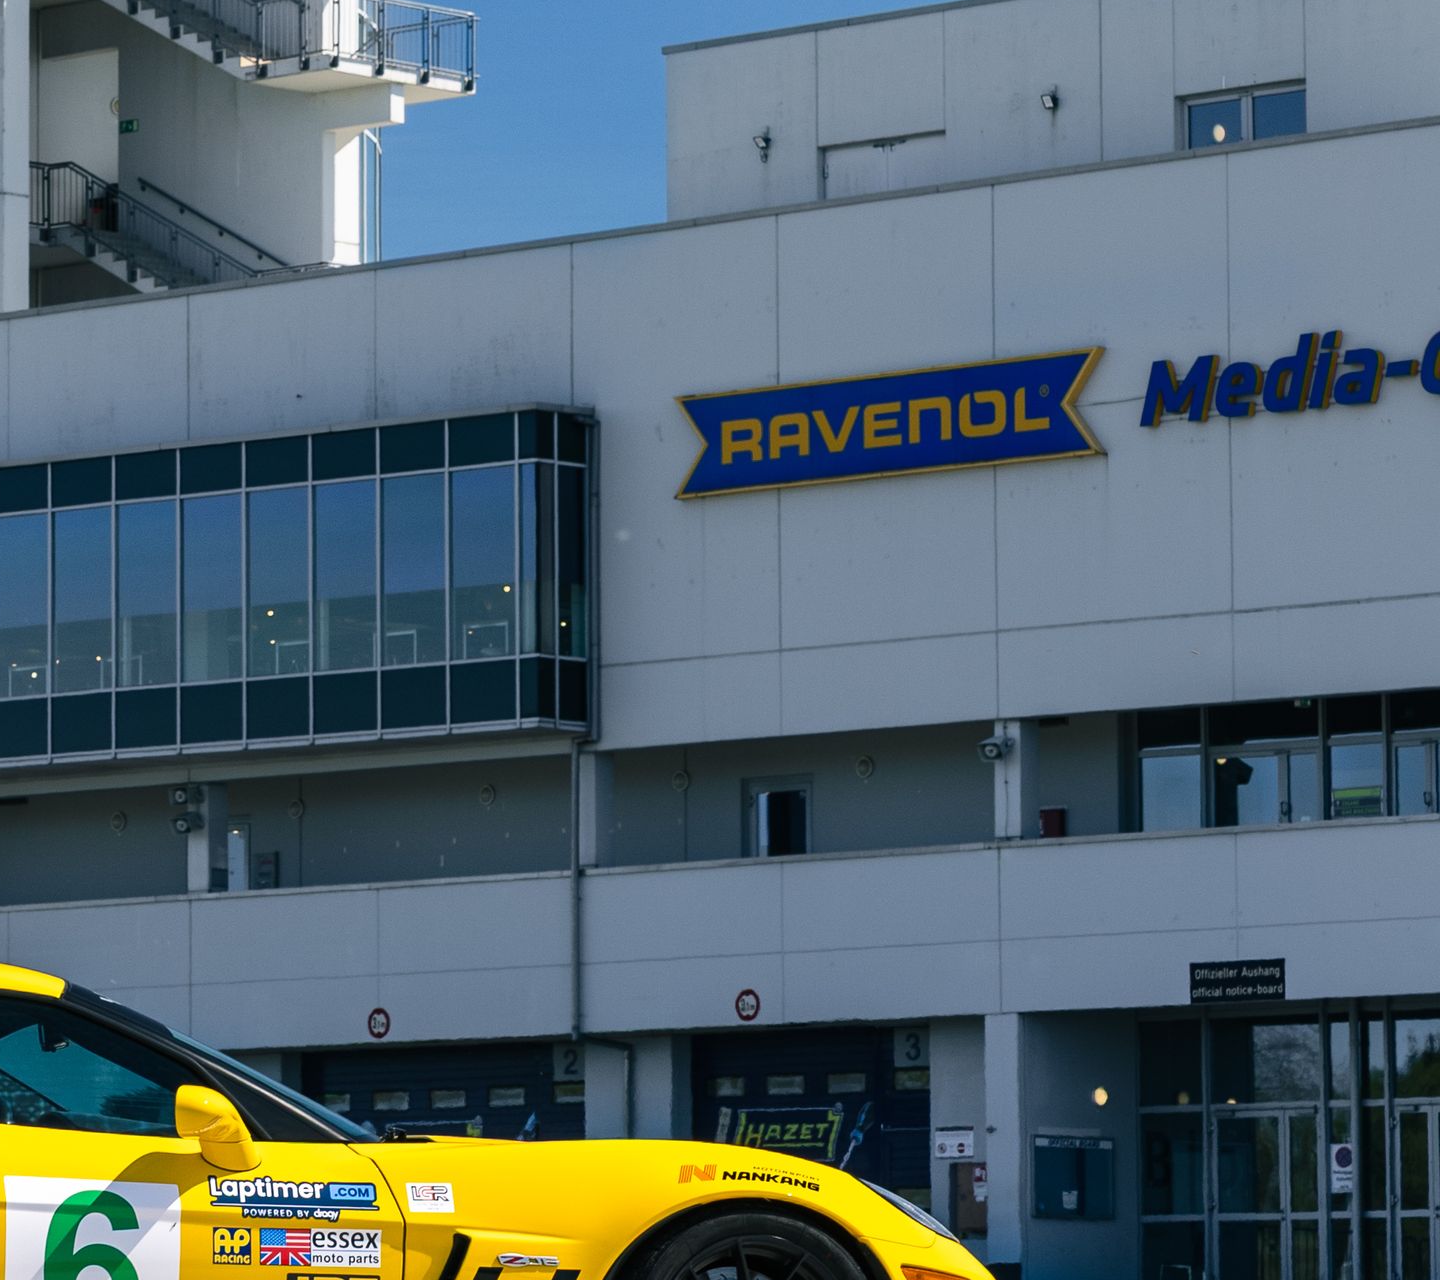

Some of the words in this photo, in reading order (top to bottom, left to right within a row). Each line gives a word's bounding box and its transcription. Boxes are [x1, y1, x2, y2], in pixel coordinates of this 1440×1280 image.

[1194, 967, 1238, 981] Offizieller
[1241, 965, 1281, 979] Aushang
[1192, 985, 1224, 998] official
[1225, 982, 1284, 997] notice-board
[905, 1031, 921, 1061] 3
[563, 1048, 578, 1075] 2
[743, 1122, 829, 1148] HAZET
[210, 1176, 325, 1203] Laptimer
[334, 1187, 370, 1198] .COM
[722, 1170, 820, 1192] NANKANG
[410, 1185, 449, 1202] LGR
[243, 1208, 293, 1218] POWERED
[297, 1209, 310, 1218] BY
[313, 1208, 339, 1220] dragy
[214, 1227, 251, 1253] AP
[312, 1230, 379, 1249] essex
[214, 1254, 251, 1264] RACING
[312, 1253, 344, 1264] moto
[348, 1253, 380, 1266] parts
